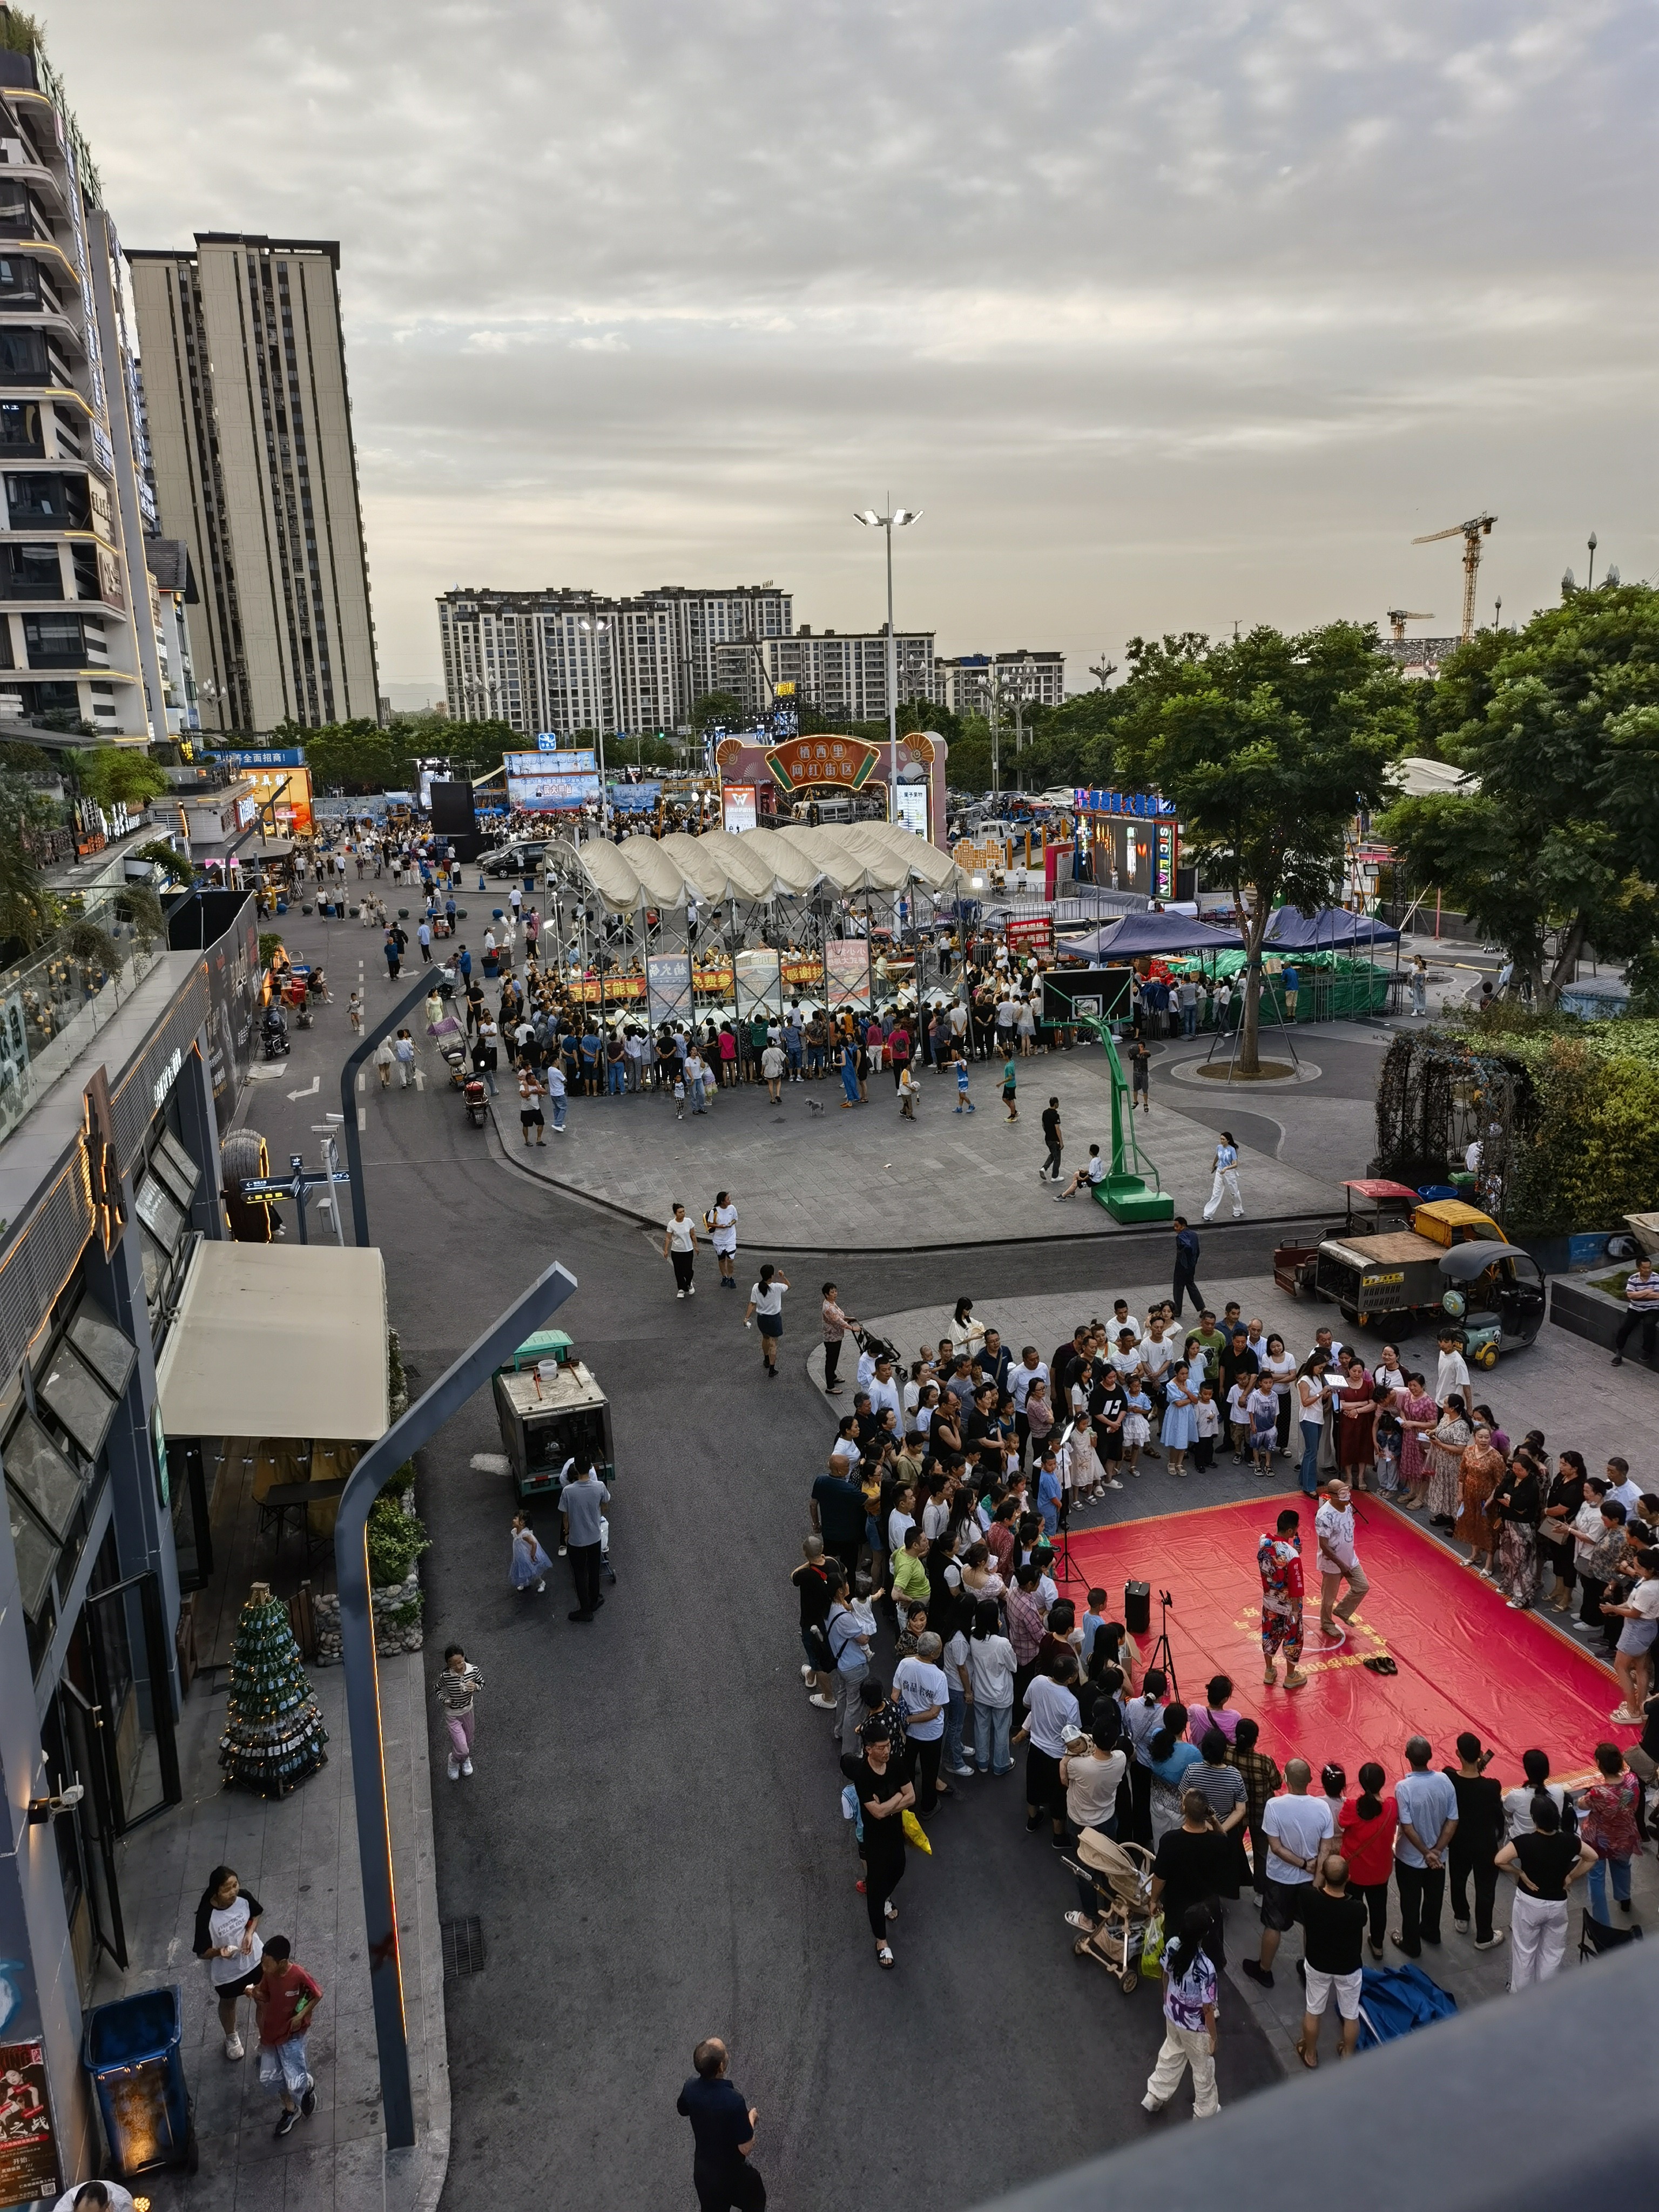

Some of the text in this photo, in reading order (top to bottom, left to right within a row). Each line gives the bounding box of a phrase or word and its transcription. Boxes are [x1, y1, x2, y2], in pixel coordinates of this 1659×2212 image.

[800, 745, 844, 758] 栖西里
[792, 763, 852, 777] 网红街区
[1159, 827, 1168, 894] SICILIAN
